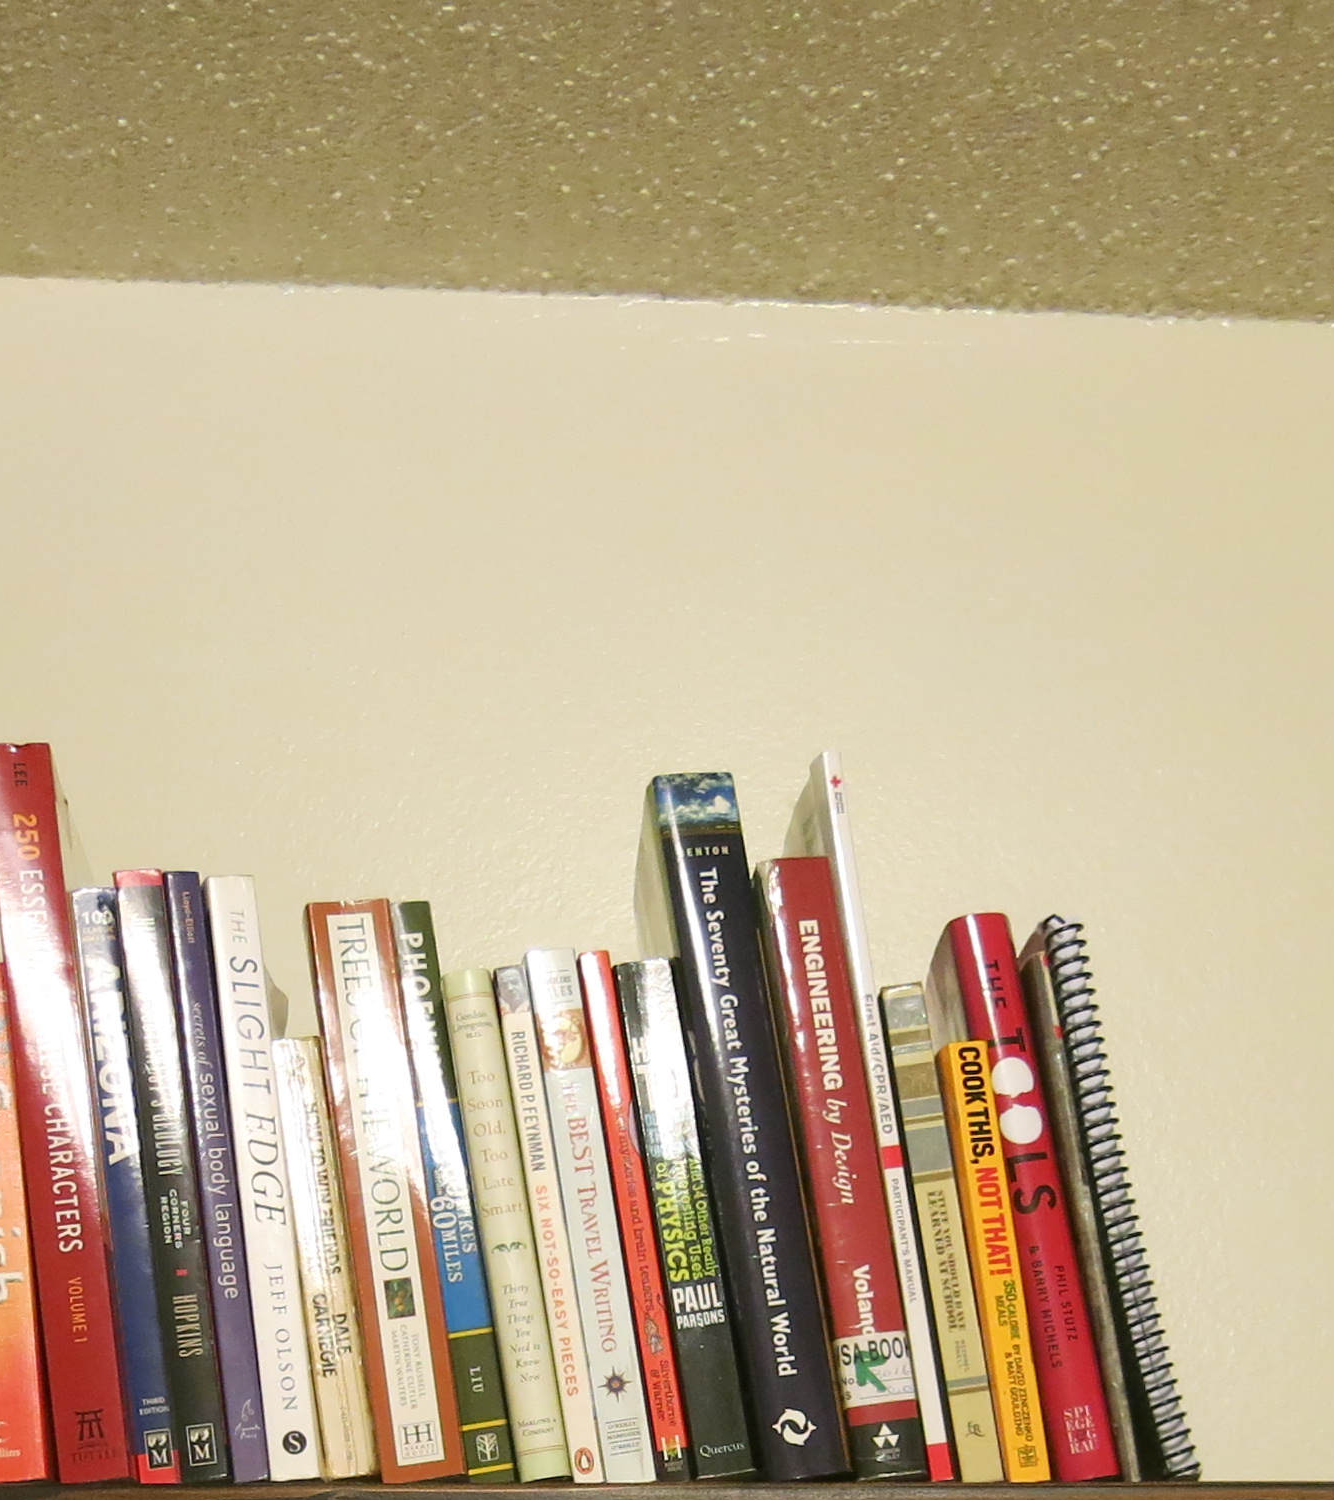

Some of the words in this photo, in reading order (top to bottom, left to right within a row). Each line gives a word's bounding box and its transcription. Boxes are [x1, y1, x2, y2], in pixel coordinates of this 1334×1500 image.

[13, 763, 28, 787] LEE
[698, 867, 718, 904] The
[229, 909, 248, 944] THE
[705, 906, 731, 989] Seventy
[797, 918, 843, 1092] ENGINEERING
[984, 959, 1008, 1009] THE
[192, 1002, 211, 1048] secrets
[229, 956, 272, 1097] SLIGHT
[719, 993, 742, 1051] Great
[864, 993, 876, 1027] First
[14, 815, 40, 861] 250
[44, 1104, 84, 1253] CHARACTERS
[195, 1050, 210, 1073] of
[469, 1070, 496, 1085] Too
[511, 1031, 533, 1091] RICHARD
[867, 1032, 893, 1135] Aid/CPR/AED
[958, 1045, 988, 1104] COOK
[199, 1073, 225, 1142] sexual
[467, 1096, 504, 1114] Soon
[725, 1055, 759, 1155] Mysteries
[822, 1098, 848, 1124] by
[481, 1148, 509, 1164] Too
[521, 1106, 547, 1172] FEYNMAN
[567, 1116, 596, 1180] BEST
[968, 1106, 996, 1166] THIS,
[204, 1147, 232, 1197] body
[245, 1111, 288, 1227] EDGE
[482, 1174, 515, 1191] Late
[746, 1160, 767, 1182] of
[831, 1130, 858, 1205] Design
[974, 1166, 1004, 1208] NOT
[159, 1195, 172, 1244] REGION
[169, 1188, 185, 1249] CORNERS
[180, 1199, 197, 1236] FOUR
[366, 1145, 410, 1272] WORLD
[430, 1195, 457, 1230] 60
[481, 1201, 525, 1218] Smart
[535, 1185, 551, 1209] SIX
[695, 1200, 712, 1236] Other
[750, 1187, 771, 1222] the
[321, 1208, 343, 1276] FRIENDS
[576, 1185, 603, 1258] TRAVEL
[655, 1180, 690, 1283] PHYSICS
[891, 1178, 909, 1256] PARTICIPANT'S
[901, 1258, 918, 1304] MANUAL
[927, 1191, 946, 1256] LEARNED
[981, 1207, 1013, 1278] THAT!
[213, 1201, 239, 1300] language
[440, 1229, 463, 1284] MILES
[540, 1218, 569, 1329] NOT-SO-EASY
[688, 1244, 704, 1280] Uses
[701, 1237, 718, 1278] Really
[756, 1228, 787, 1307] Natural
[938, 1260, 950, 1276] AT
[263, 1263, 288, 1315] JEFF
[502, 1283, 529, 1296] Thirty
[672, 1281, 724, 1314] PAUL
[947, 1252, 962, 1298] SHOULD
[1032, 1259, 1047, 1305] BARRY
[1054, 1265, 1068, 1296] PHIL
[68, 1276, 88, 1335] VOLUME
[172, 1294, 203, 1358] HOPKINS
[507, 1313, 535, 1325] Things
[508, 1298, 528, 1309] True
[589, 1260, 617, 1353] WRITING
[675, 1308, 727, 1331] PARSONS
[941, 1279, 958, 1333] SCHOOL
[953, 1300, 967, 1331] HAVE
[994, 1294, 1009, 1327] MEALS
[1060, 1301, 1079, 1341] STUTZ
[312, 1293, 338, 1379] CARNEGIE
[332, 1314, 352, 1355] DALE
[391, 1330, 403, 1365] MARTIN
[400, 1324, 413, 1373] CATHERINE
[510, 1342, 532, 1355] Need
[515, 1328, 531, 1338] You
[770, 1312, 797, 1377] World
[1039, 1309, 1063, 1368] MICHELS
[275, 1328, 299, 1411] OLSON
[470, 1366, 484, 1393] LIU
[516, 1357, 540, 1369] Know
[520, 1373, 541, 1384] Now
[559, 1338, 579, 1397] PIECES
[1005, 1360, 1017, 1386] MATT
[139, 1405, 170, 1415] EDITION
[142, 1397, 166, 1406] THIRD
[395, 1366, 408, 1408] WALTERS
[405, 1374, 418, 1410] CUTLER
[651, 1380, 666, 1421] Warner
[659, 1360, 677, 1427] Silverthorne
[1009, 1387, 1024, 1437] GOULDING
[1018, 1388, 1034, 1442] ZINCZENKO
[699, 1443, 747, 1458] Quercus
